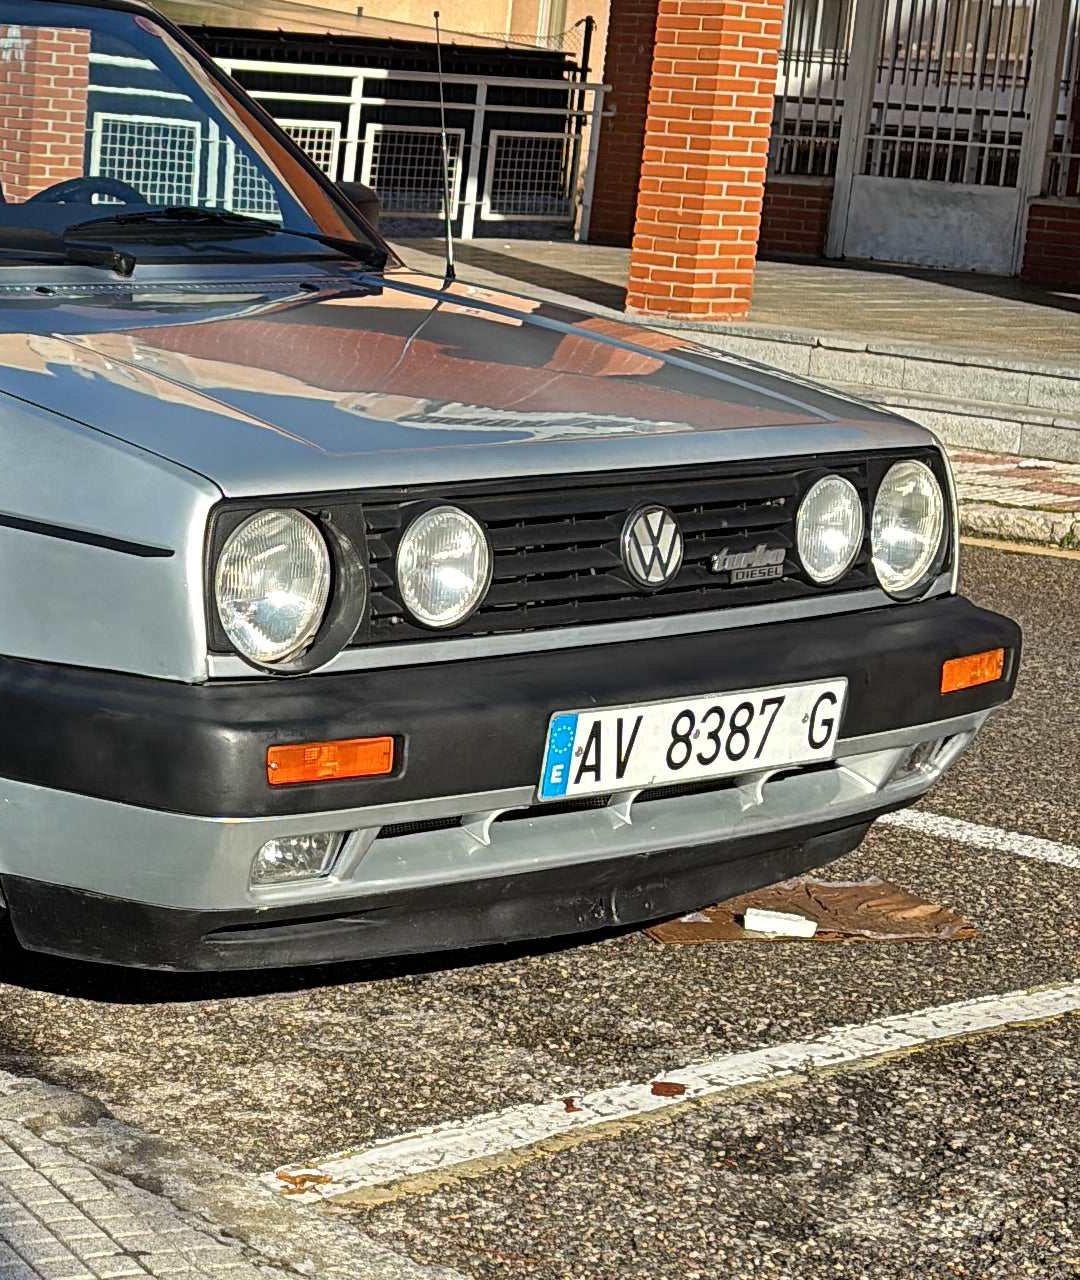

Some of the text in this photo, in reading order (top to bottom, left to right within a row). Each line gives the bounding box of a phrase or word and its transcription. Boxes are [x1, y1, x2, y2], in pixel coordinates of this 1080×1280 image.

[735, 566, 782, 580] DIESEL
[574, 691, 837, 784] AV 8387 G
[550, 764, 565, 784] E
